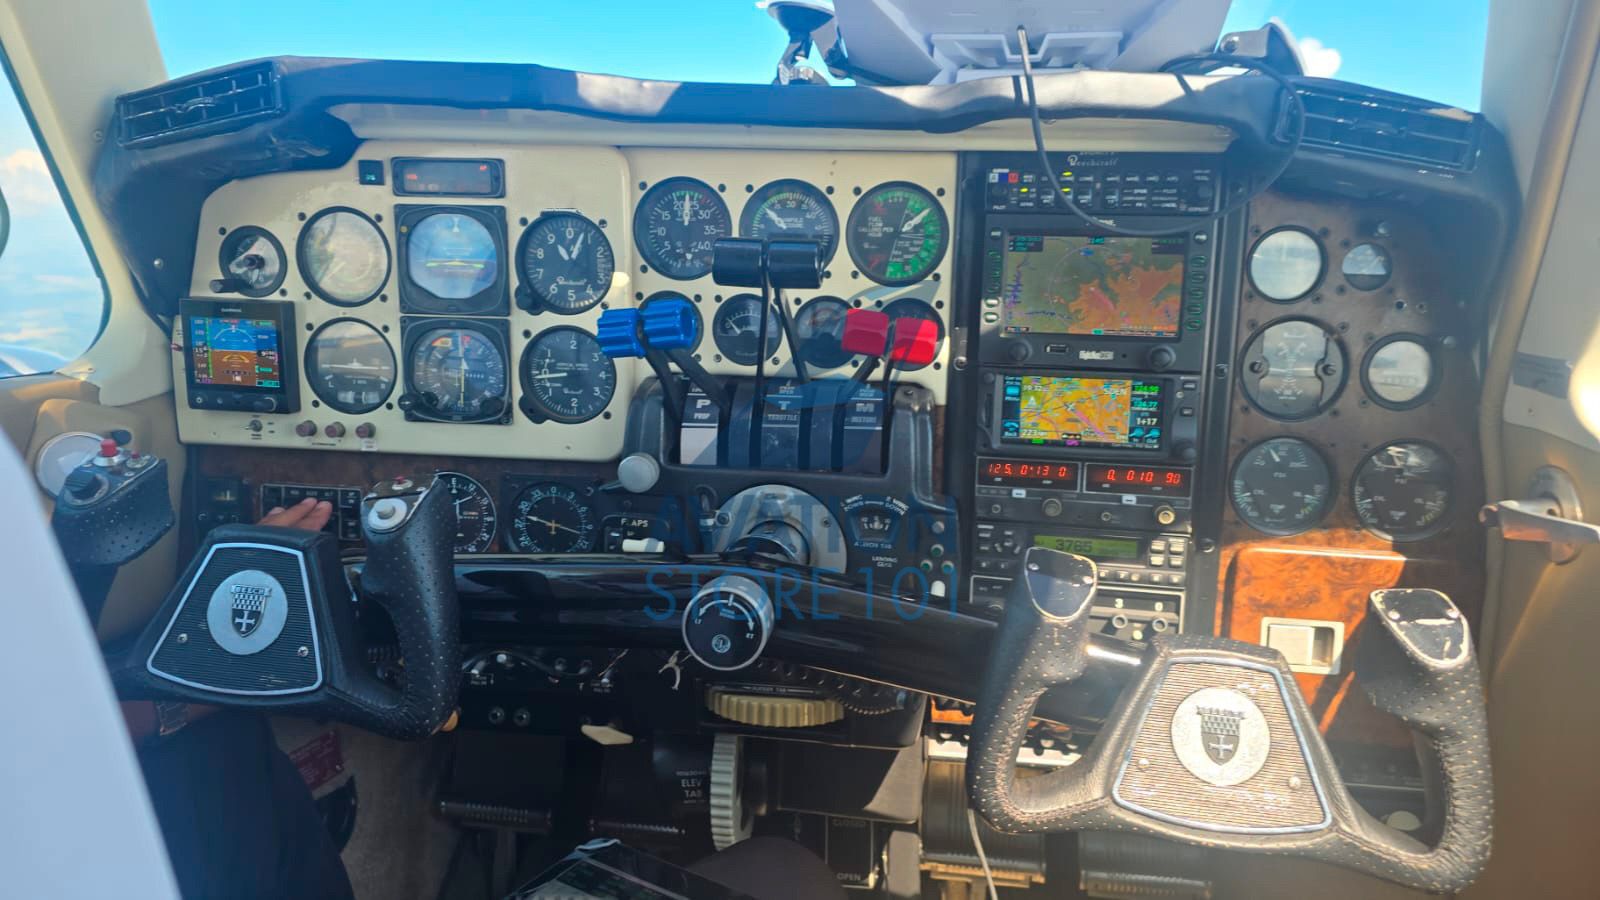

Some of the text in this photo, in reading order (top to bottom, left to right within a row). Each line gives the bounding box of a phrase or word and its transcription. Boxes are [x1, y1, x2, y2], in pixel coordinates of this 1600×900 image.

[662, 211, 671, 220] 15
[698, 211, 711, 220] 30
[566, 228, 574, 238] 0
[657, 225, 716, 236] 10 35
[547, 234, 555, 244] 9
[664, 241, 711, 250] 5 40
[536, 248, 544, 259] 8
[597, 246, 604, 257] 2
[536, 268, 544, 279] 7
[597, 273, 605, 284] 3
[549, 283, 558, 294] 6
[586, 284, 593, 294] 4
[568, 290, 576, 301] 5
[569, 340, 577, 350] 2
[591, 353, 599, 362] 3
[598, 370, 606, 380] 4
[593, 387, 601, 396] 3
[570, 398, 578, 407] 2
[696, 399, 711, 409] P
[778, 401, 791, 411] T
[855, 403, 875, 412] M
[1136, 417, 1158, 426] 1+17
[568, 491, 575, 499] 3
[620, 518, 649, 528] FAPS
[1055, 538, 1093, 553] 3765
[1114, 597, 1124, 609] 3
[681, 778, 703, 788] ELEV
[684, 789, 703, 798] TAB
[836, 872, 861, 881] OPEN
